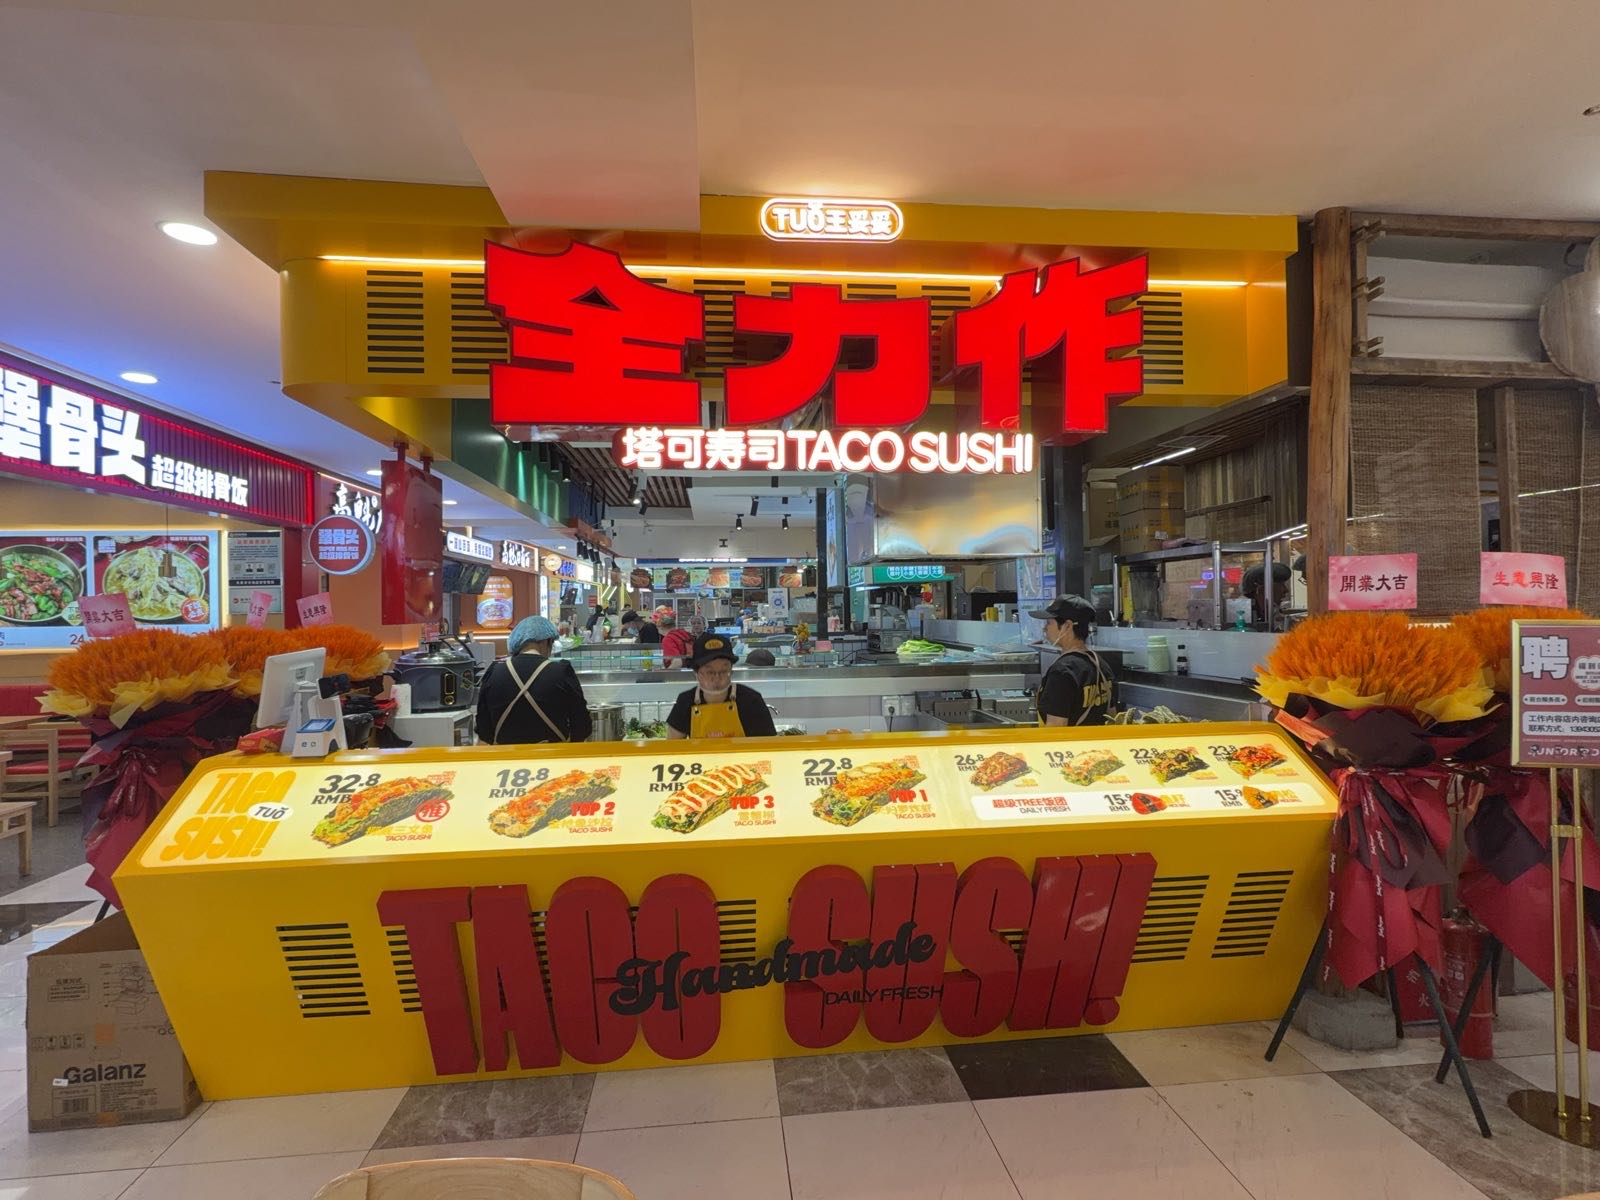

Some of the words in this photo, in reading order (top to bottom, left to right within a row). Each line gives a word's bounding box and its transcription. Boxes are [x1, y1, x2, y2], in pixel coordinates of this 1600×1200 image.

[484, 240, 1149, 433] 全力作
[621, 428, 786, 470] 塔可寿司
[786, 429, 905, 473] TACO
[909, 431, 1033, 474] SUSHI
[151, 454, 249, 507] 超级排骨饭
[1340, 574, 1409, 593] 開業大吉
[1520, 635, 1570, 680] 聘
[1045, 750, 1075, 762] 19.8
[652, 762, 703, 783] 19.8
[802, 757, 853, 778] 22.8
[318, 773, 381, 794] 32.8
[496, 768, 549, 788] 18.8
[649, 782, 685, 793] RMB
[312, 794, 352, 805] RMB
[489, 788, 527, 799] RMB
[730, 796, 760, 809] TOP
[763, 795, 775, 809] 3
[889, 789, 916, 803] TOP
[919, 789, 928, 802] 1
[1214, 789, 1243, 801] 15.9
[571, 802, 601, 816] TOP
[604, 801, 616, 816] 2
[385, 834, 409, 842] TACO
[377, 873, 722, 1076] TACO
[609, 921, 937, 1016] Handmade
[825, 988, 877, 1006] DAILY
[881, 985, 945, 1001] FRESH
[63, 1063, 147, 1084] Galanz
